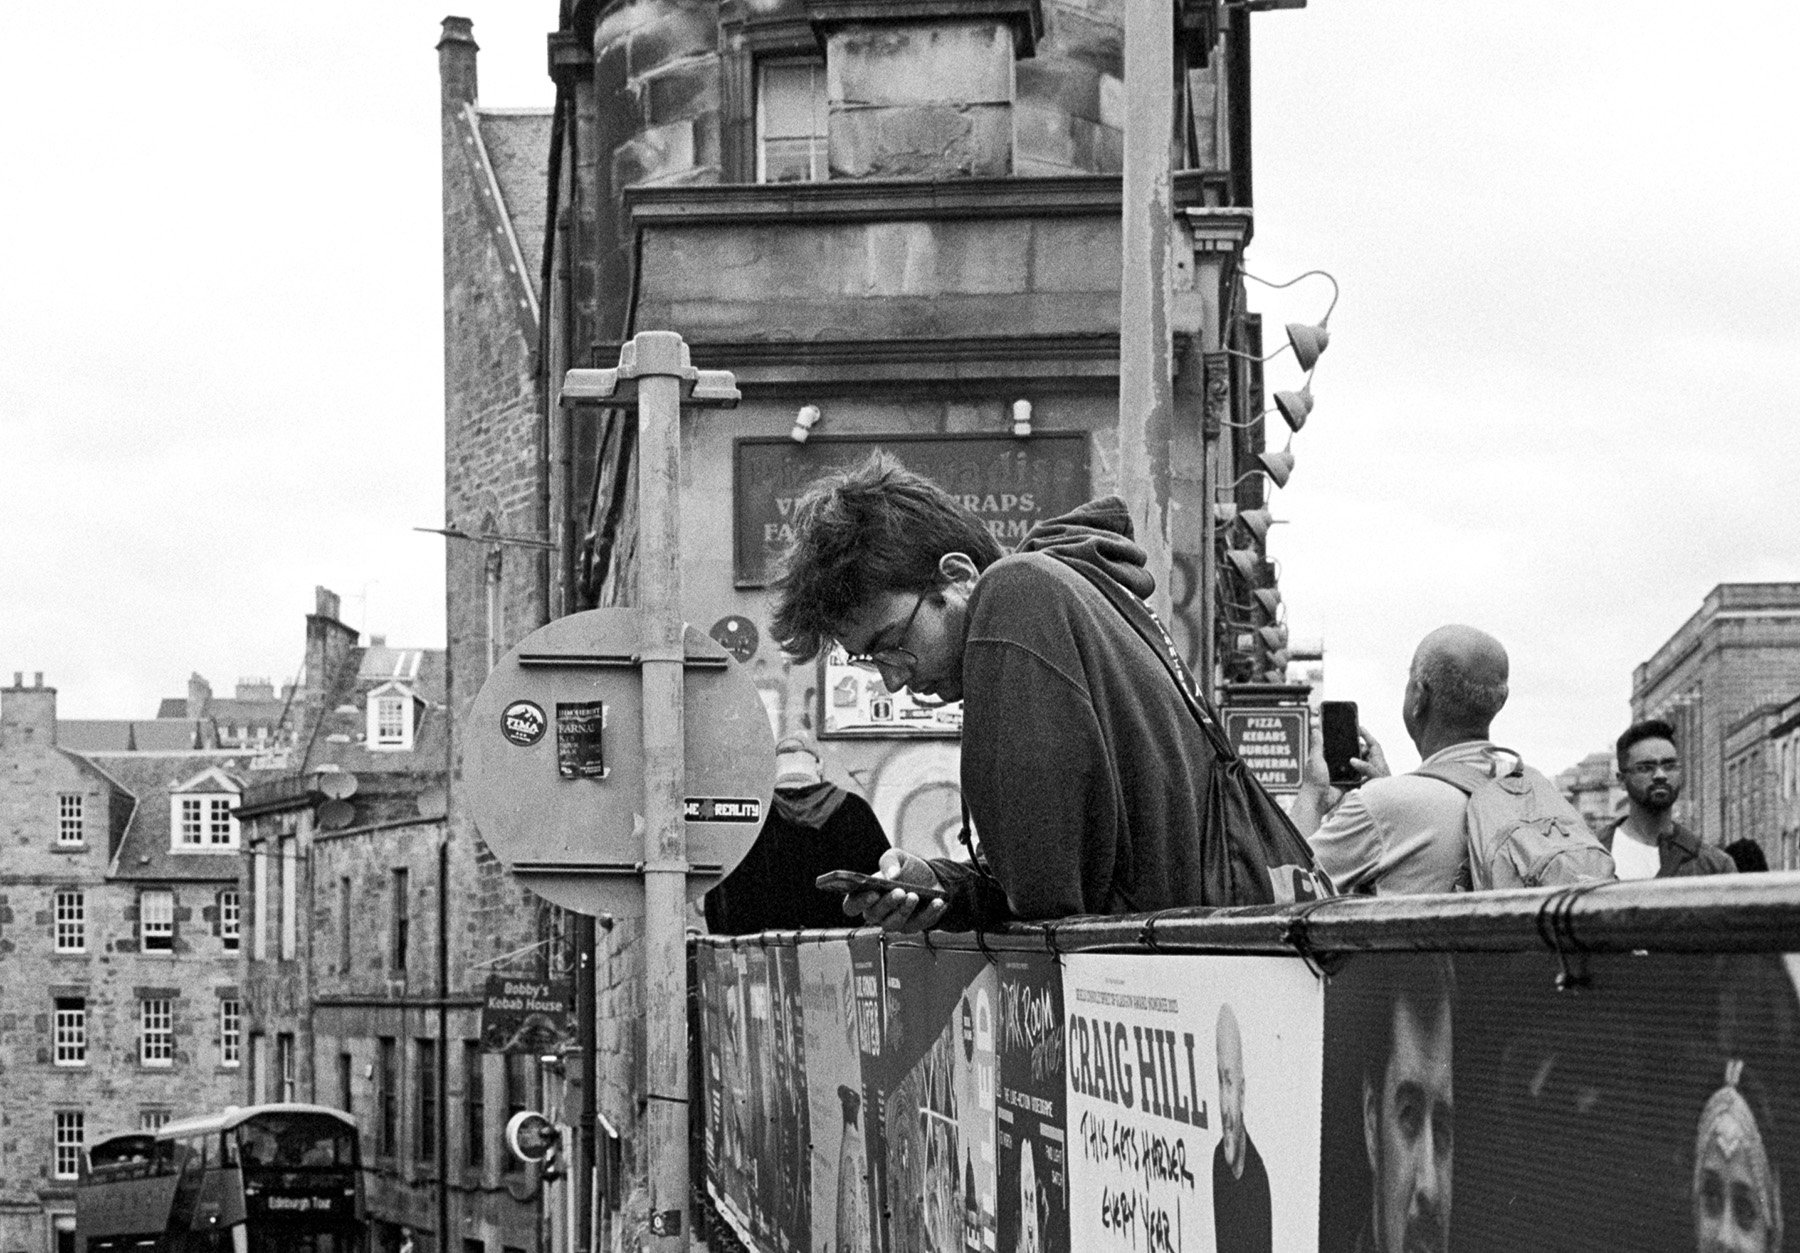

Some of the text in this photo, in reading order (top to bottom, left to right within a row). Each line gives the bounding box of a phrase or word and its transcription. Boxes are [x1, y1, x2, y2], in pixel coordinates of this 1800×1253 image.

[1247, 717, 1282, 728] PIZZA
[1238, 744, 1291, 756] BURGERS
[1244, 757, 1298, 769] AWERMA
[1252, 771, 1287, 783] LAFEL
[715, 803, 759, 816] REALITY
[504, 981, 549, 999] Bobby's
[526, 999, 563, 1012] House
[1069, 1013, 1134, 1109] CRAIG
[1133, 1025, 1209, 1130] HILL
